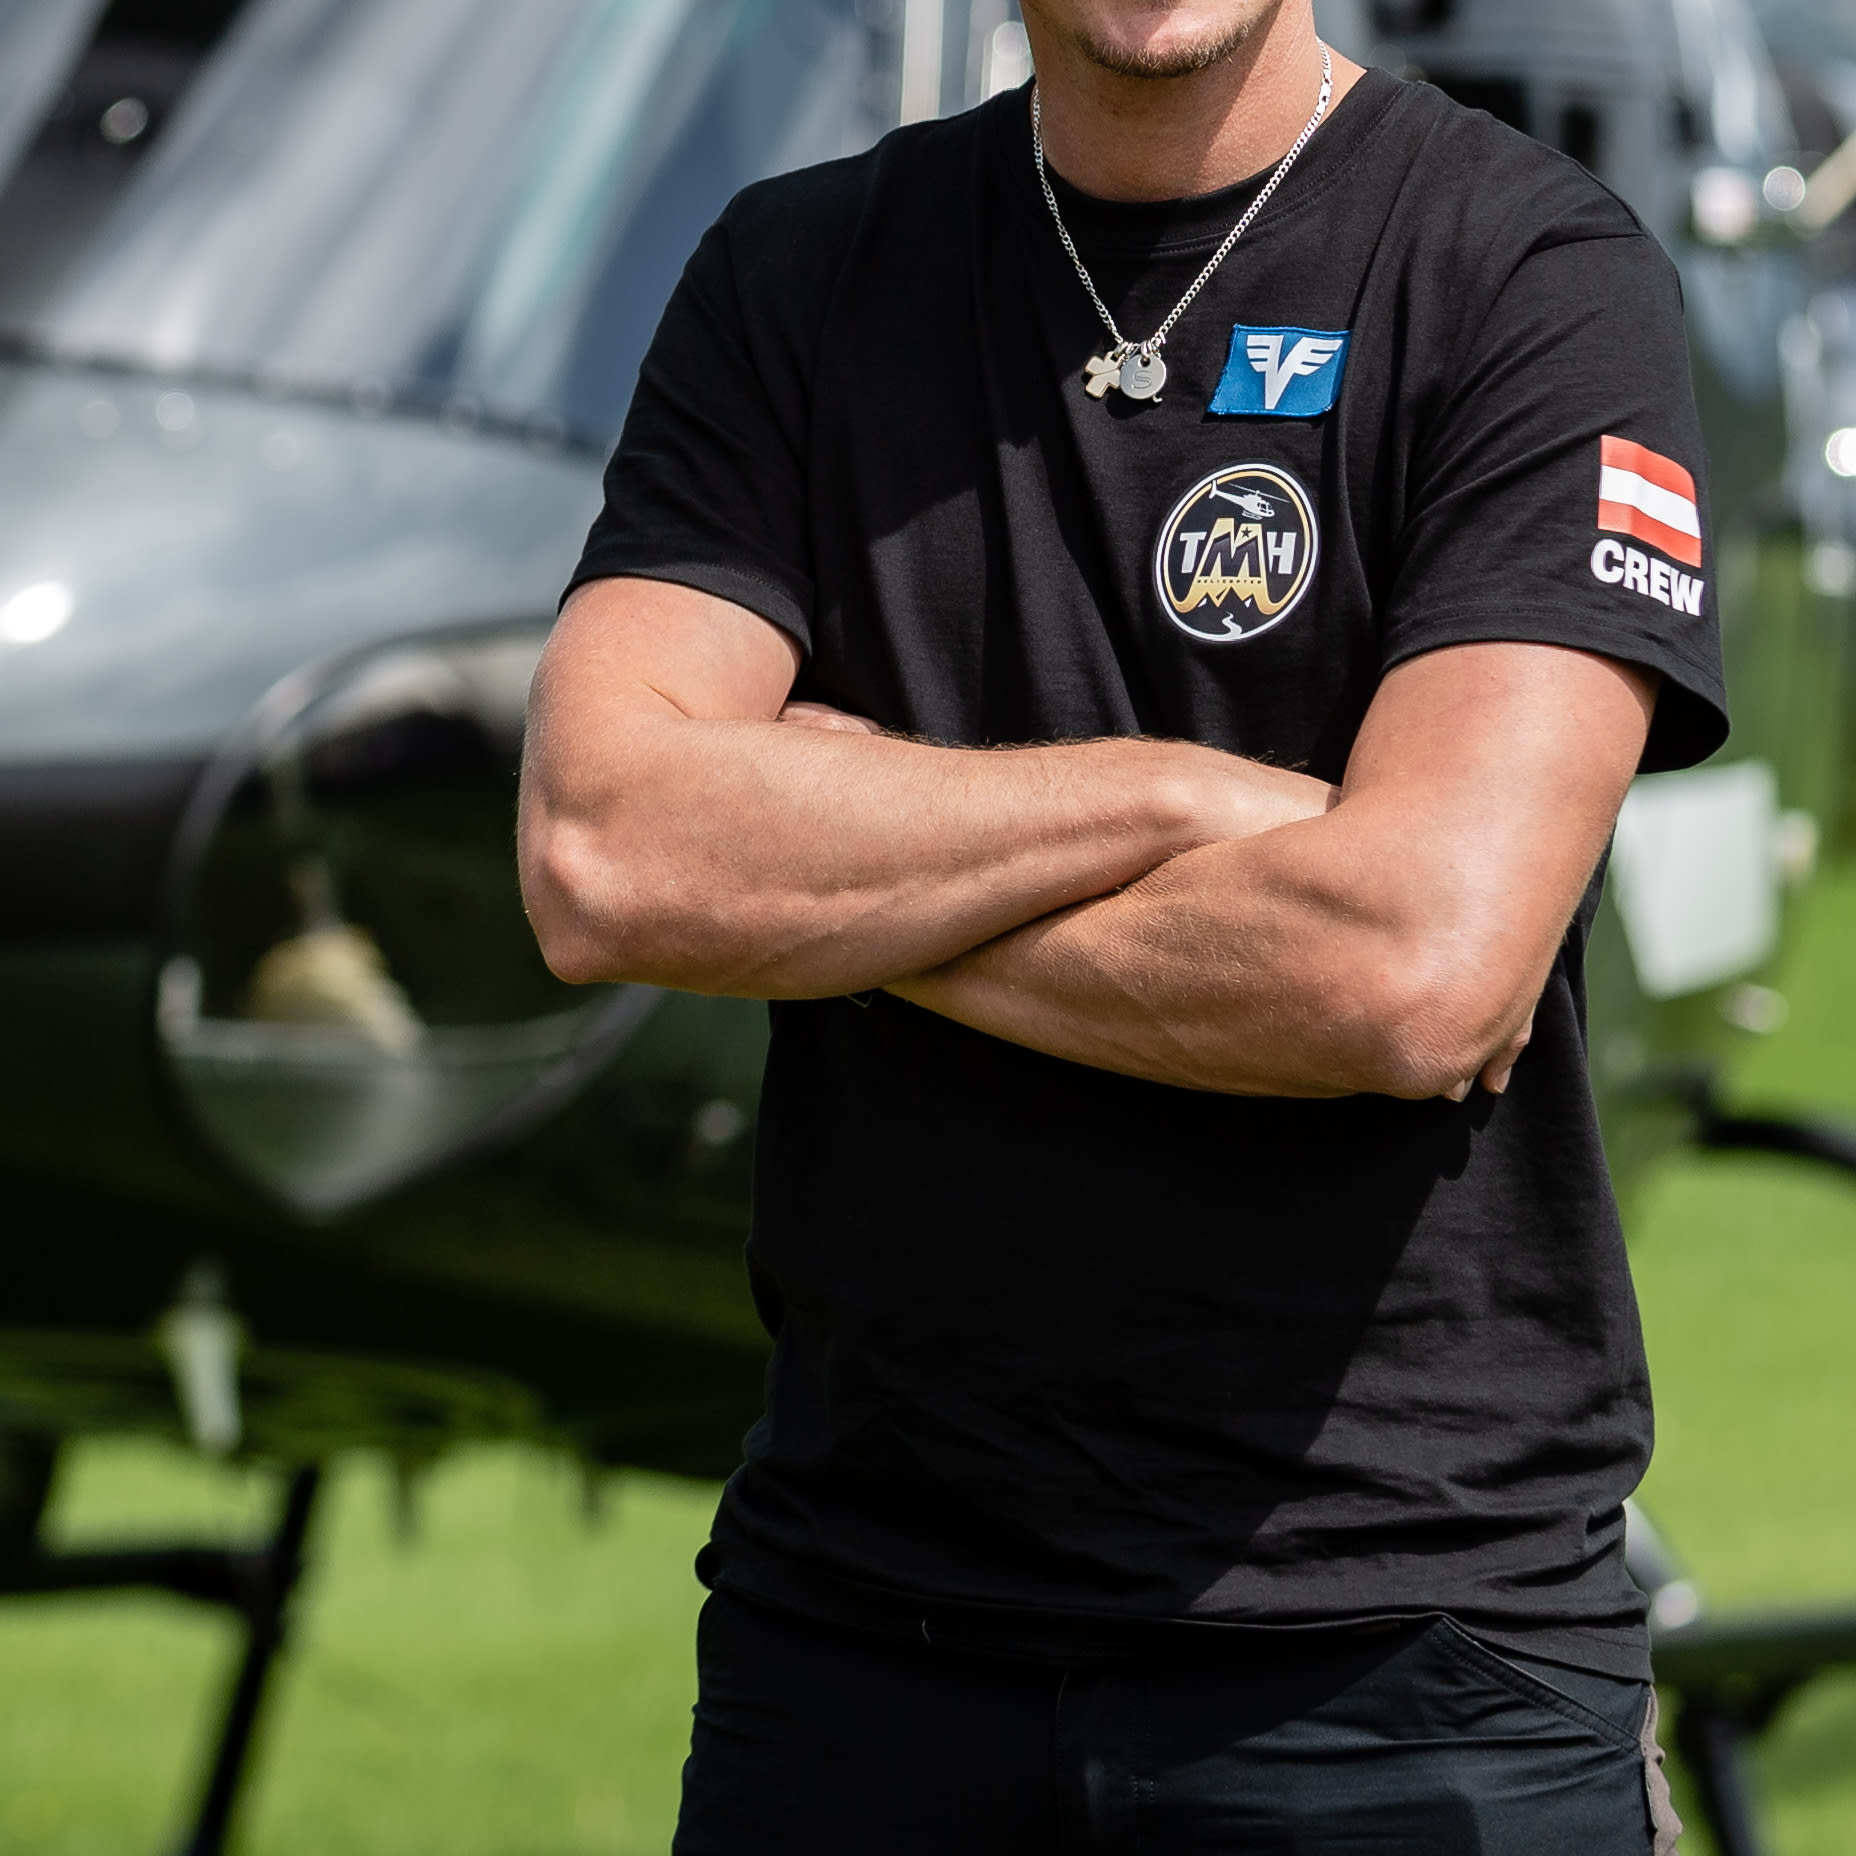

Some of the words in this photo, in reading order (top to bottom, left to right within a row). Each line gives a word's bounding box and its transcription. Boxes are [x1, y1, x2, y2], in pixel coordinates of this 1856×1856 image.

[1132, 369, 1153, 390] S
[1179, 517, 1297, 575] TMH
[1590, 538, 1705, 617] CREW
